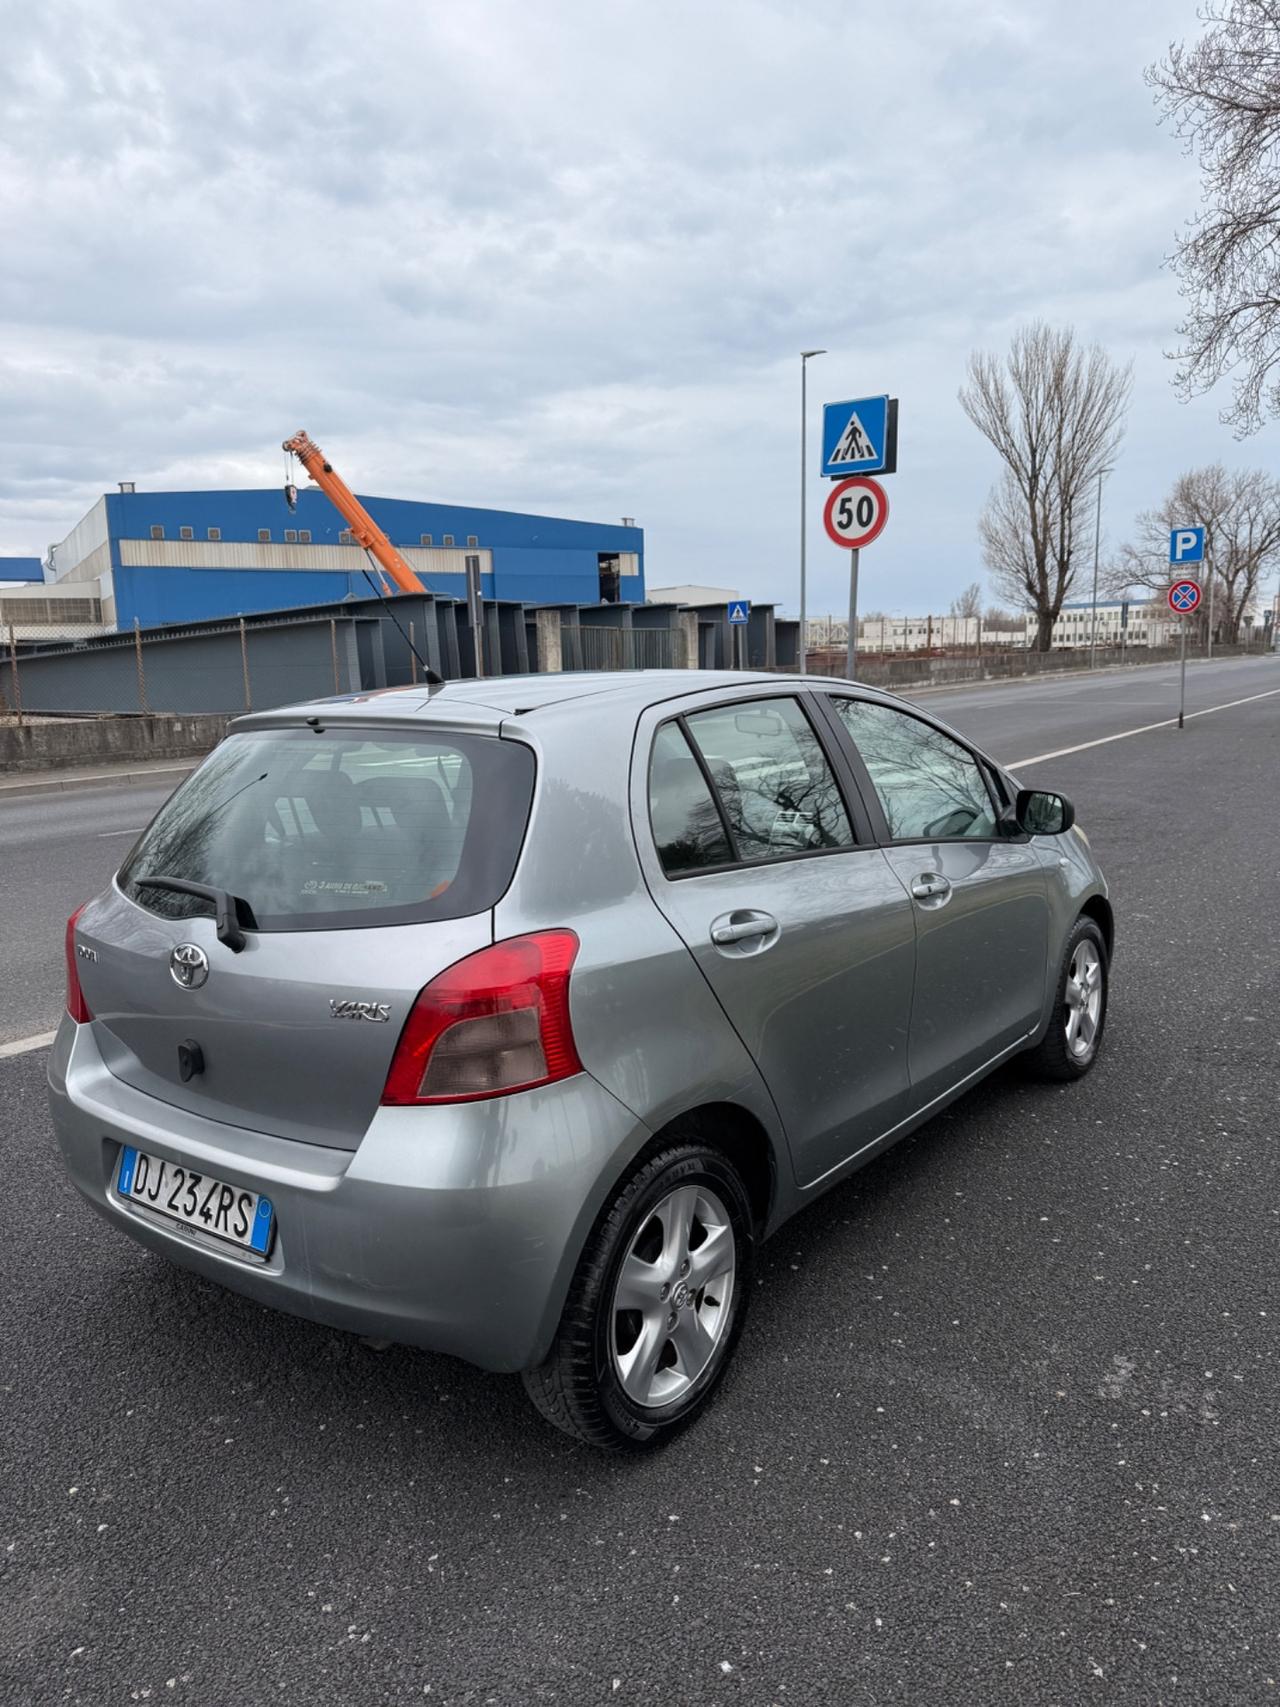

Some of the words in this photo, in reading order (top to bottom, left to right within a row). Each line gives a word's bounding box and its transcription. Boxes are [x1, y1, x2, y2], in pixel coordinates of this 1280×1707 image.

[837, 495, 874, 530] 50
[1175, 531, 1198, 560] P
[133, 1153, 166, 1201] DJ
[166, 1168, 253, 1238] 234RS
